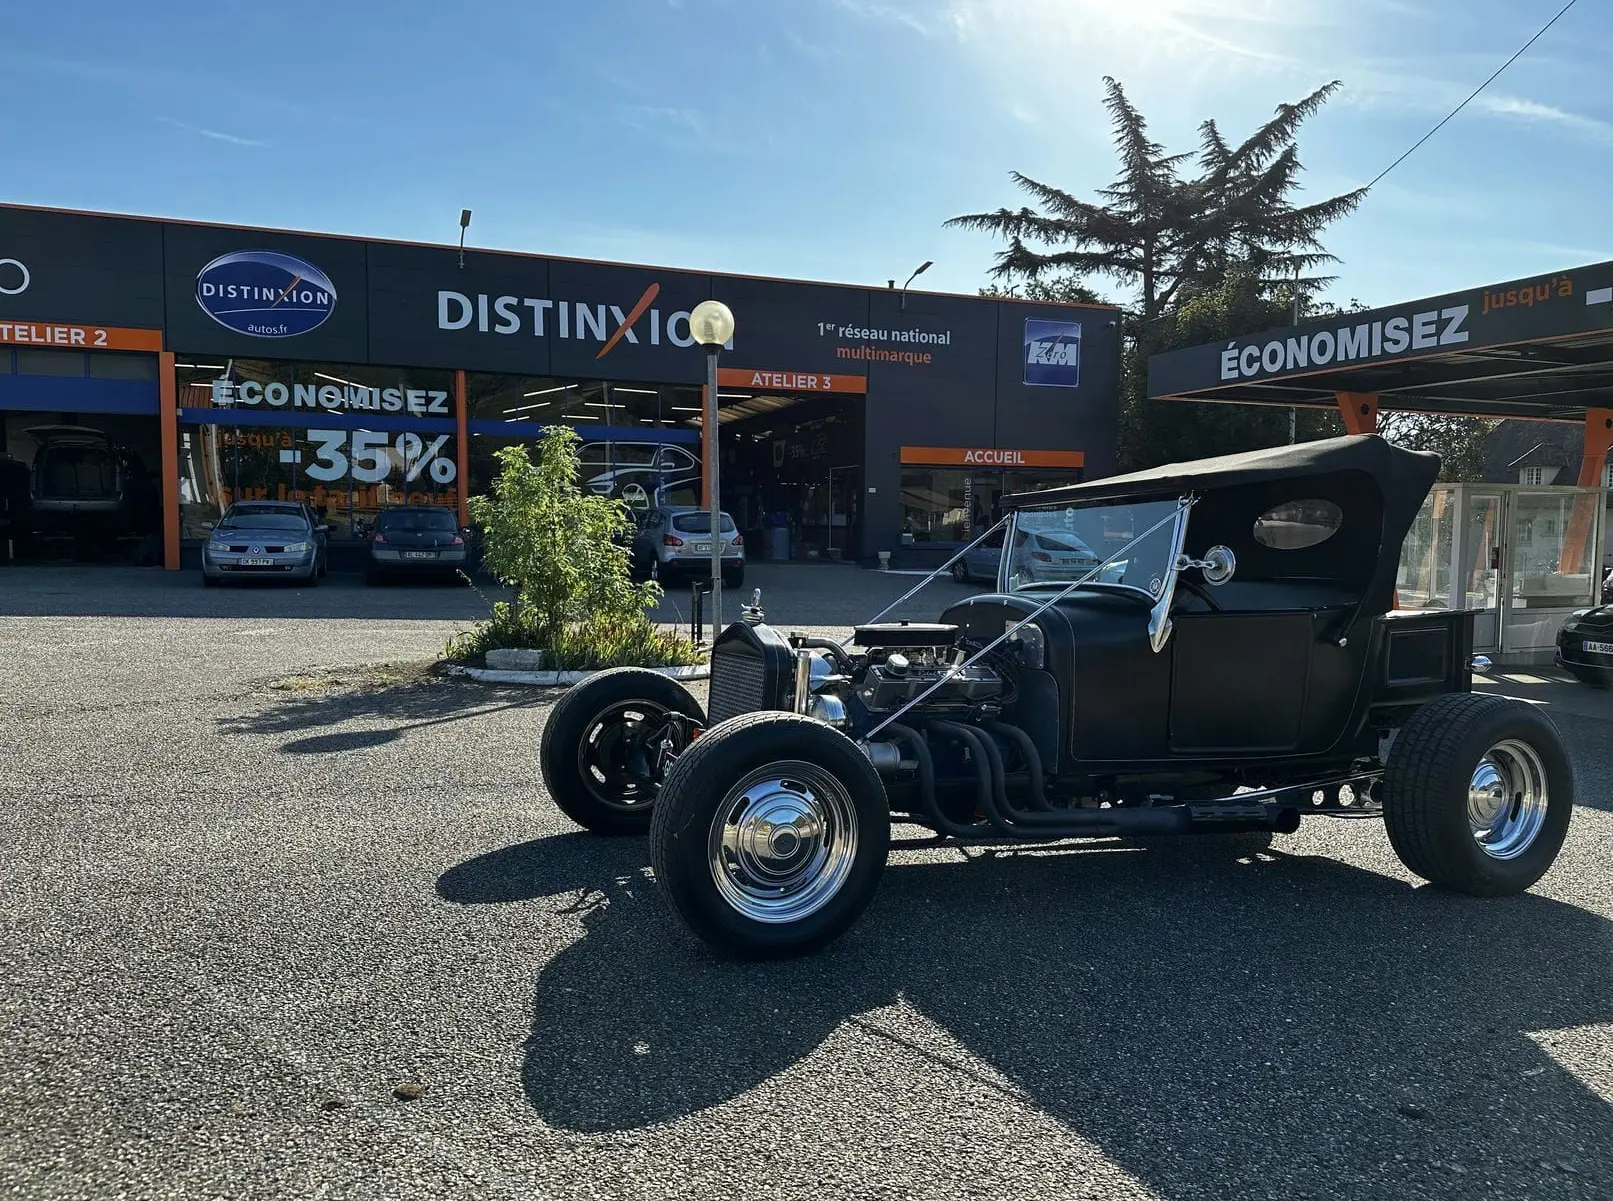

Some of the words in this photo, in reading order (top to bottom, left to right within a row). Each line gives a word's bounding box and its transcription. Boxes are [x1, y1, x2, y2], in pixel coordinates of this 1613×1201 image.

[202, 277, 329, 308] DISTINXION
[1482, 275, 1573, 314] jusqu'à
[247, 323, 289, 336] autos.fr
[437, 283, 734, 360] DISTINXIO
[93, 329, 108, 346] 2
[838, 324, 888, 341] réseau
[890, 328, 951, 346] national
[1220, 304, 1469, 380] ÉCONOMISEZ
[836, 345, 932, 364] multimarque
[751, 372, 818, 389] ATELIER
[822, 376, 832, 390] 3
[212, 376, 449, 414] ÉCONOMISEZ
[279, 429, 457, 484] -35%
[963, 450, 1026, 465] ACCUEIL
